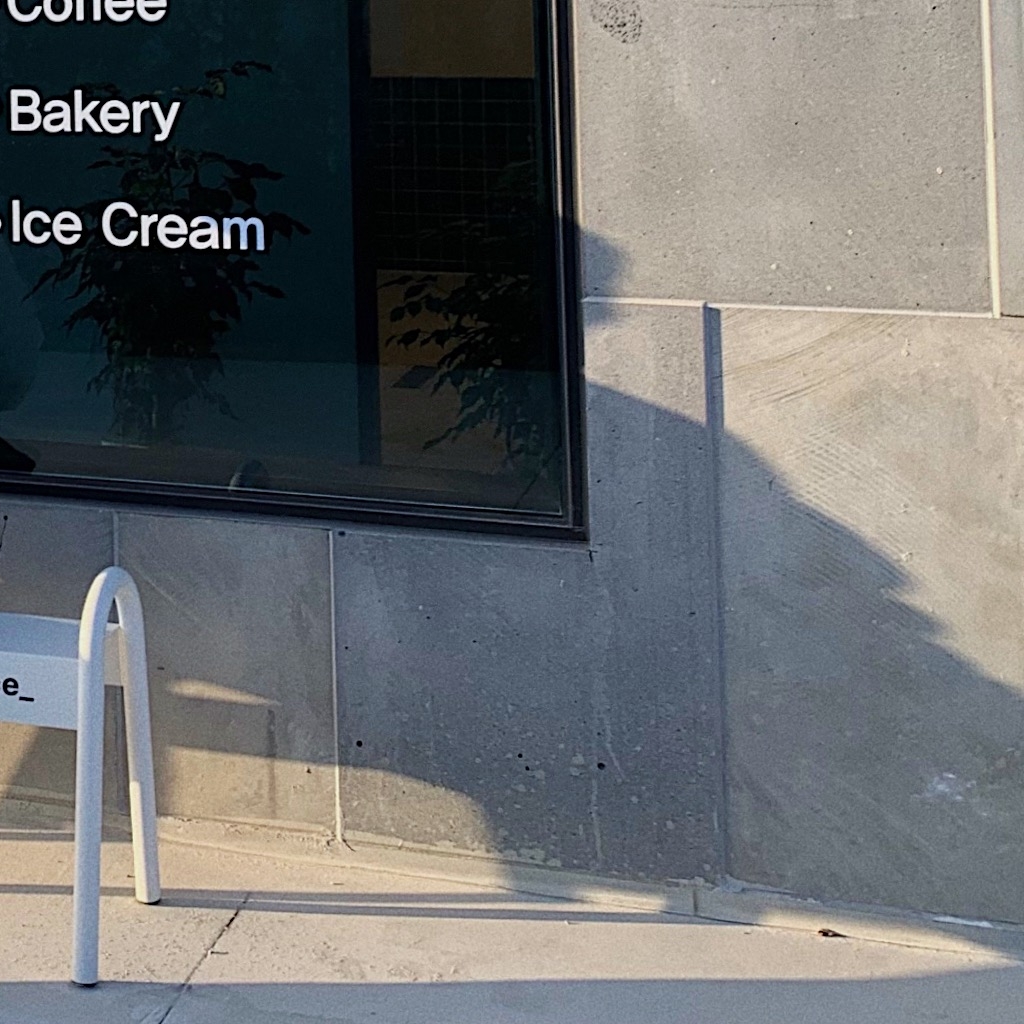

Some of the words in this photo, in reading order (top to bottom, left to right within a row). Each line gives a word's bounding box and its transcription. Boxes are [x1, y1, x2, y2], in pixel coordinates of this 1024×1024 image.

[9, 88, 181, 143] Bakery
[11, 199, 83, 246] Ice
[101, 201, 267, 252] Cream
